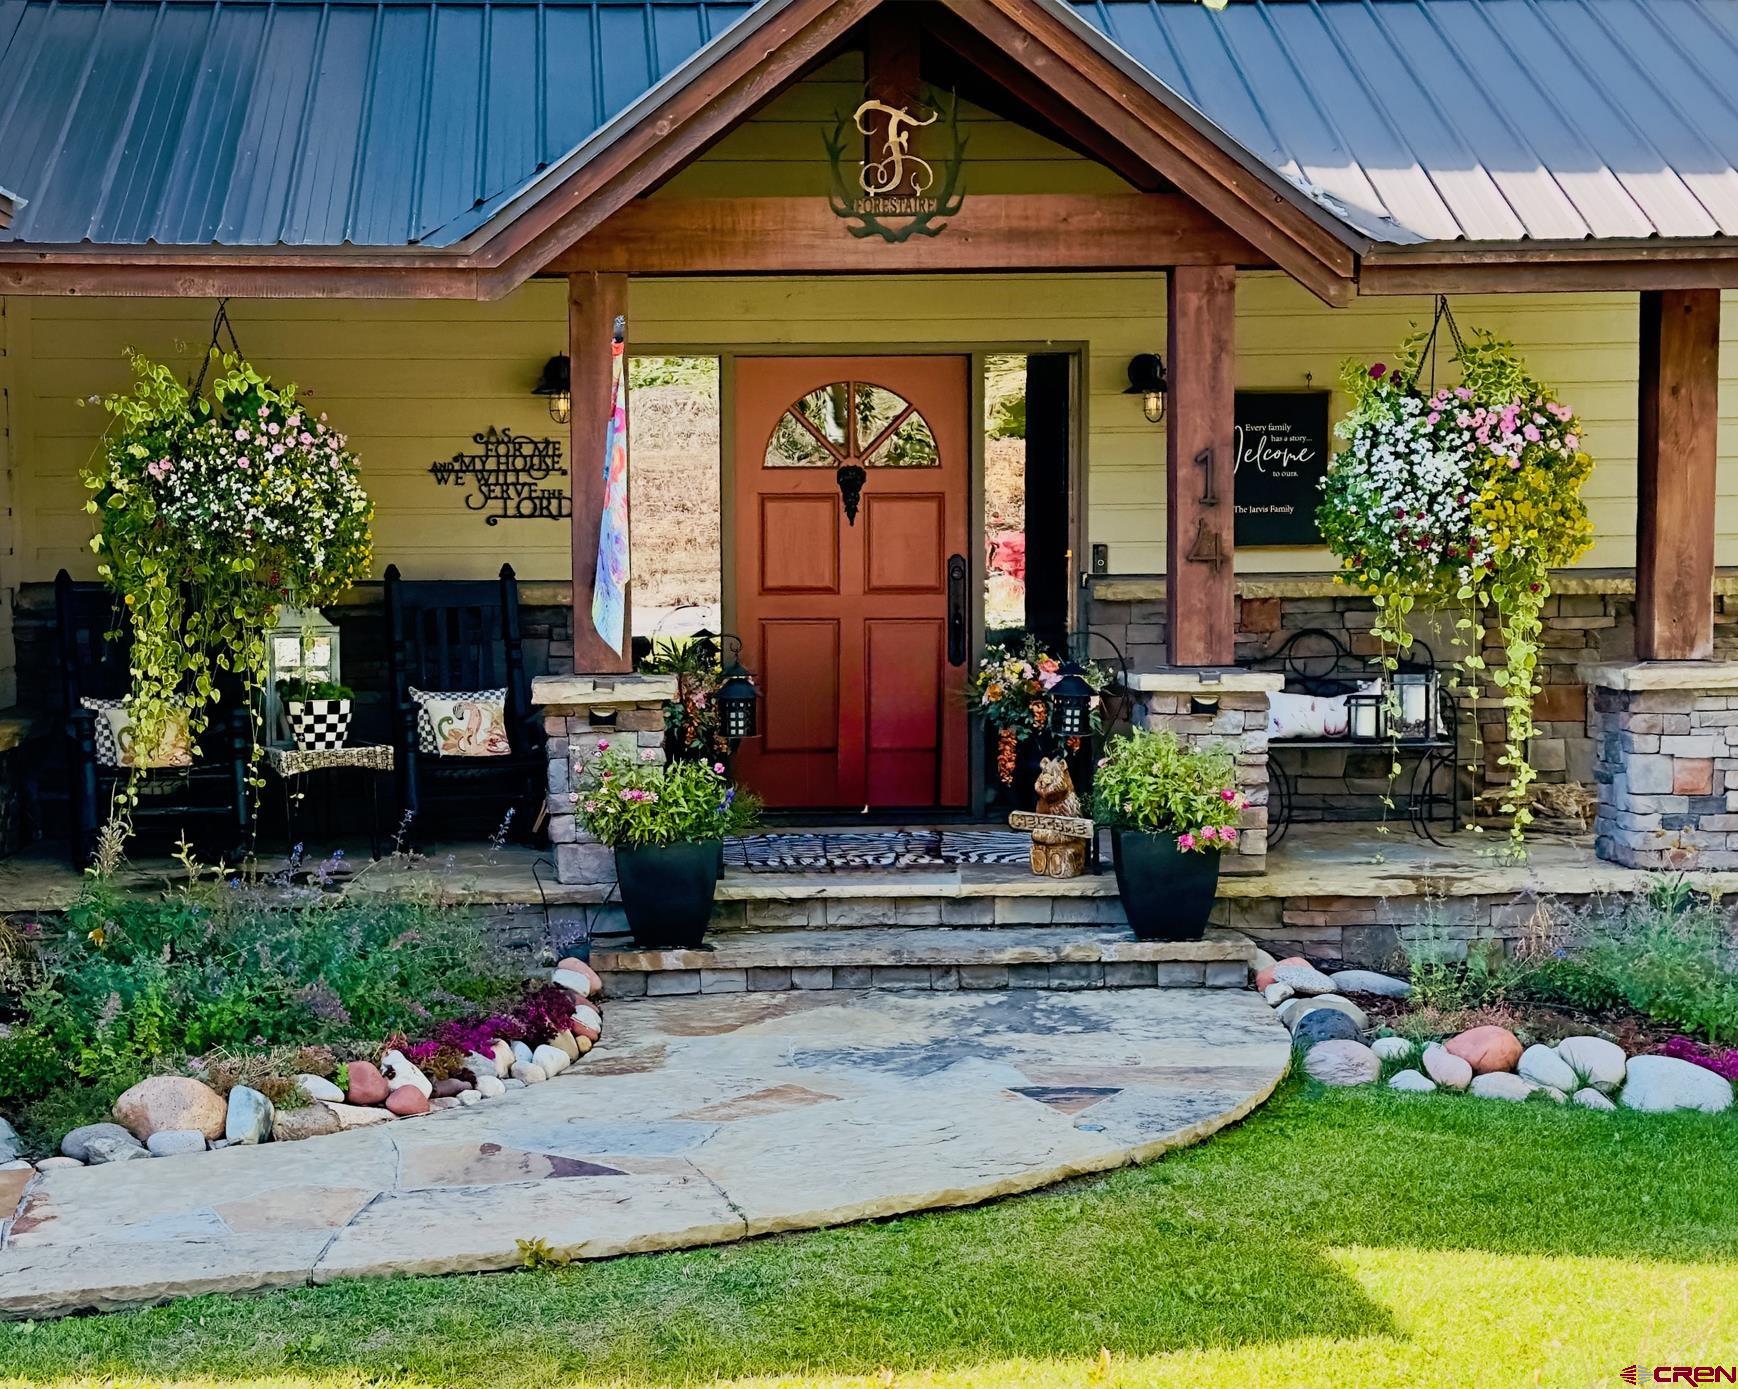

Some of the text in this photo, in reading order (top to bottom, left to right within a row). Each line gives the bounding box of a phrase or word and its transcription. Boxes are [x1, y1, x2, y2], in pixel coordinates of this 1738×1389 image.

[855, 198, 935, 214] FORESTAIRE
[486, 425, 511, 443] AS
[1245, 423, 1292, 434] Every family
[485, 441, 562, 456] FOR ME
[432, 461, 454, 471] AND
[459, 455, 489, 471] MY
[434, 471, 465, 486] WE
[472, 483, 564, 502] SERVE THE
[1235, 504, 1294, 515] The Jarvis Family
